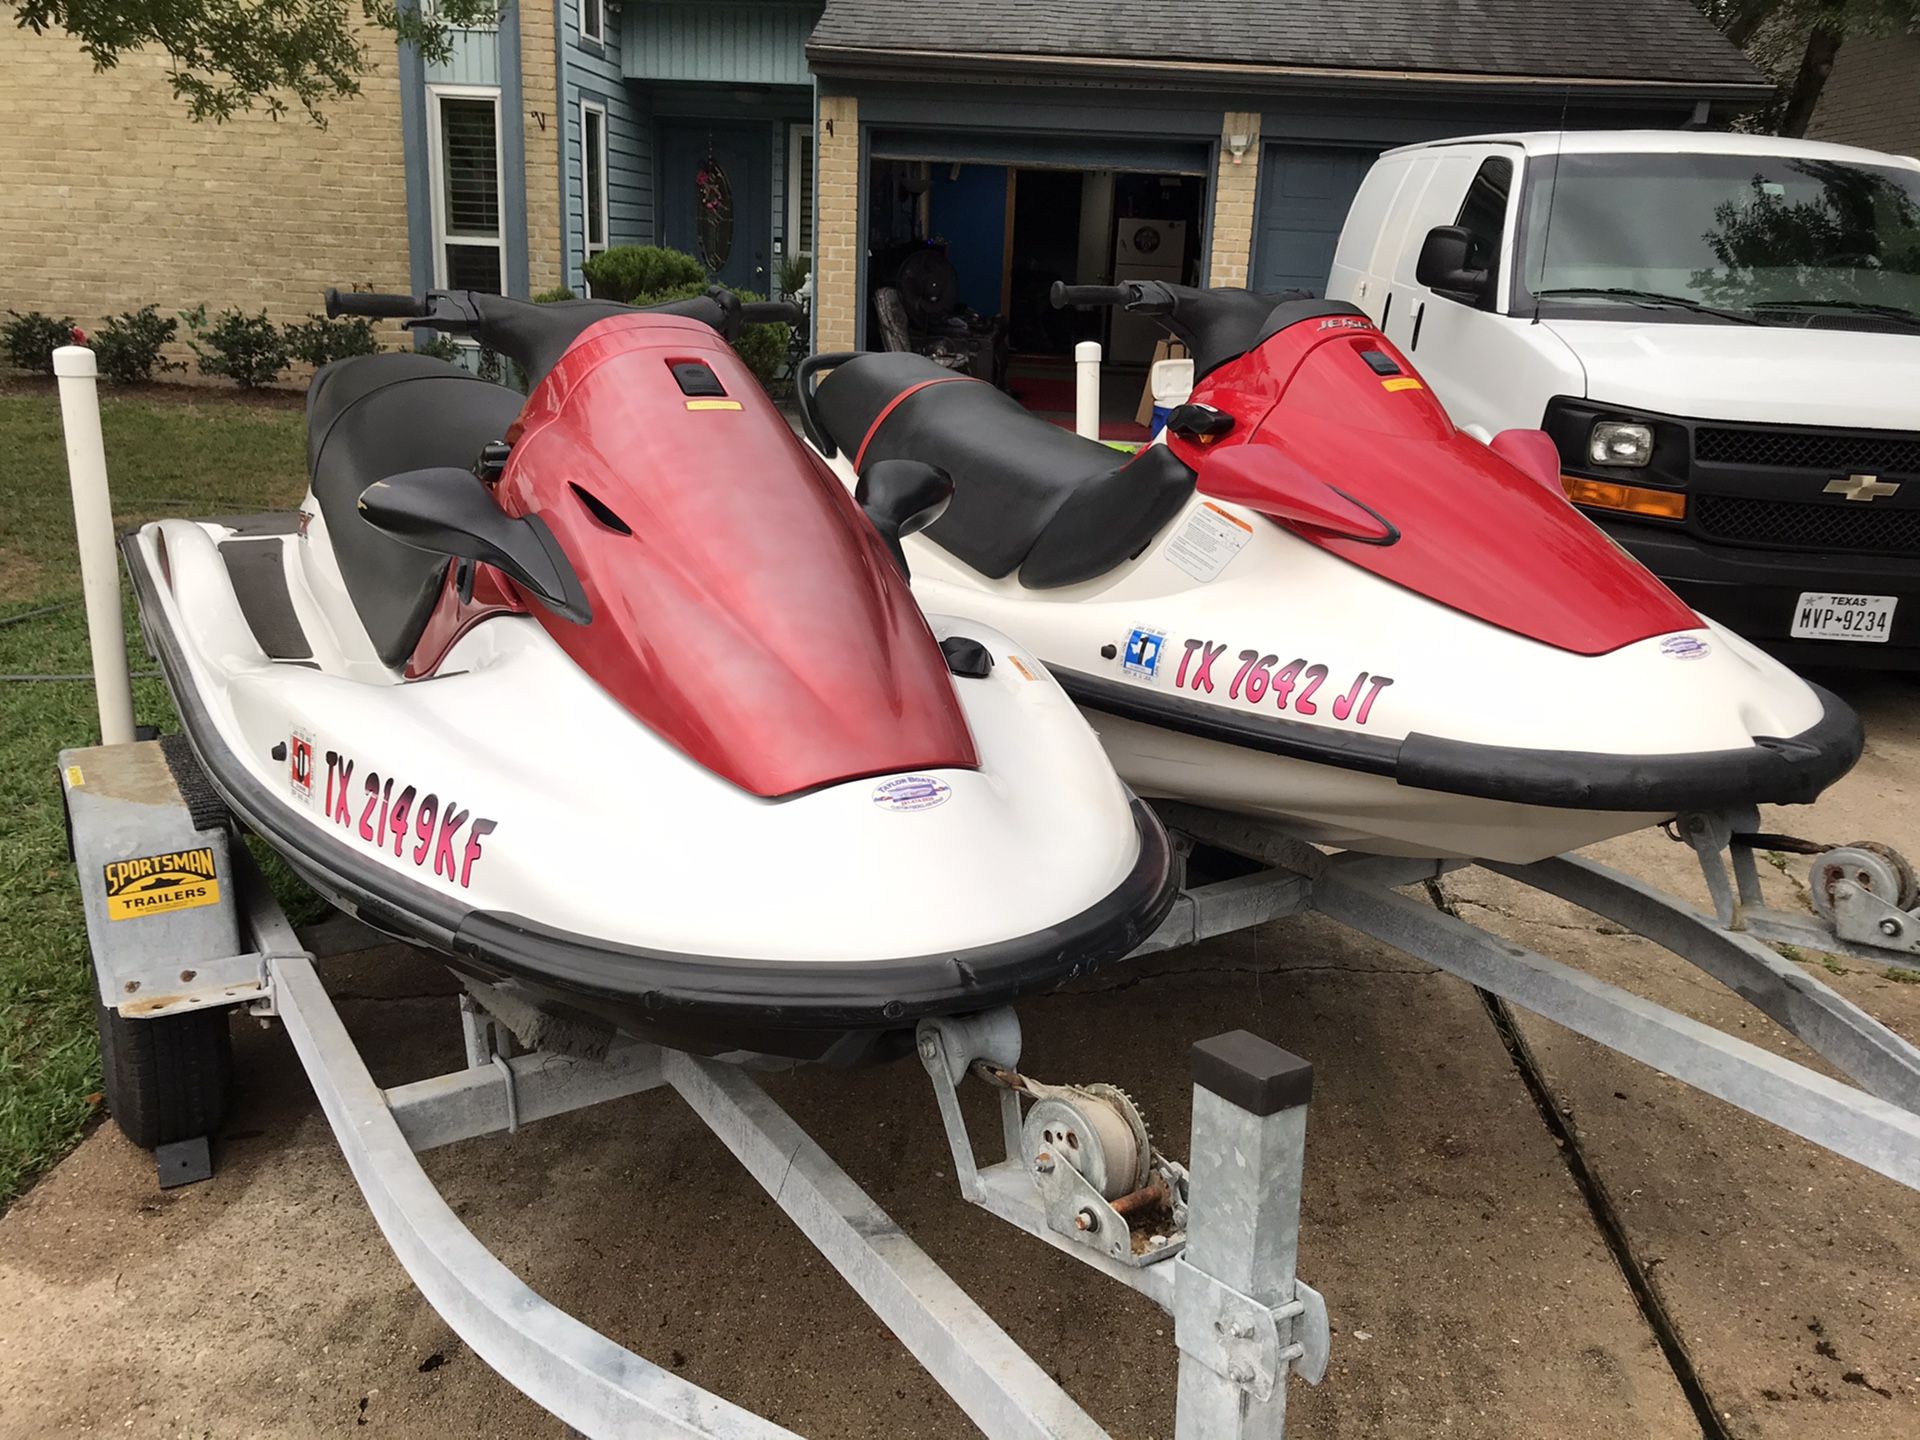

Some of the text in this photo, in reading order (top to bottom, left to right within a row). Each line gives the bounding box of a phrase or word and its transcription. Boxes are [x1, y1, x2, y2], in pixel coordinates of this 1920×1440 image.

[1831, 596, 1867, 606] TEXAS
[1175, 638, 1394, 724] TX 7642 JT
[326, 750, 354, 828] TX
[106, 848, 215, 895] SPORTSMAN
[123, 887, 206, 909] TRAILERS
